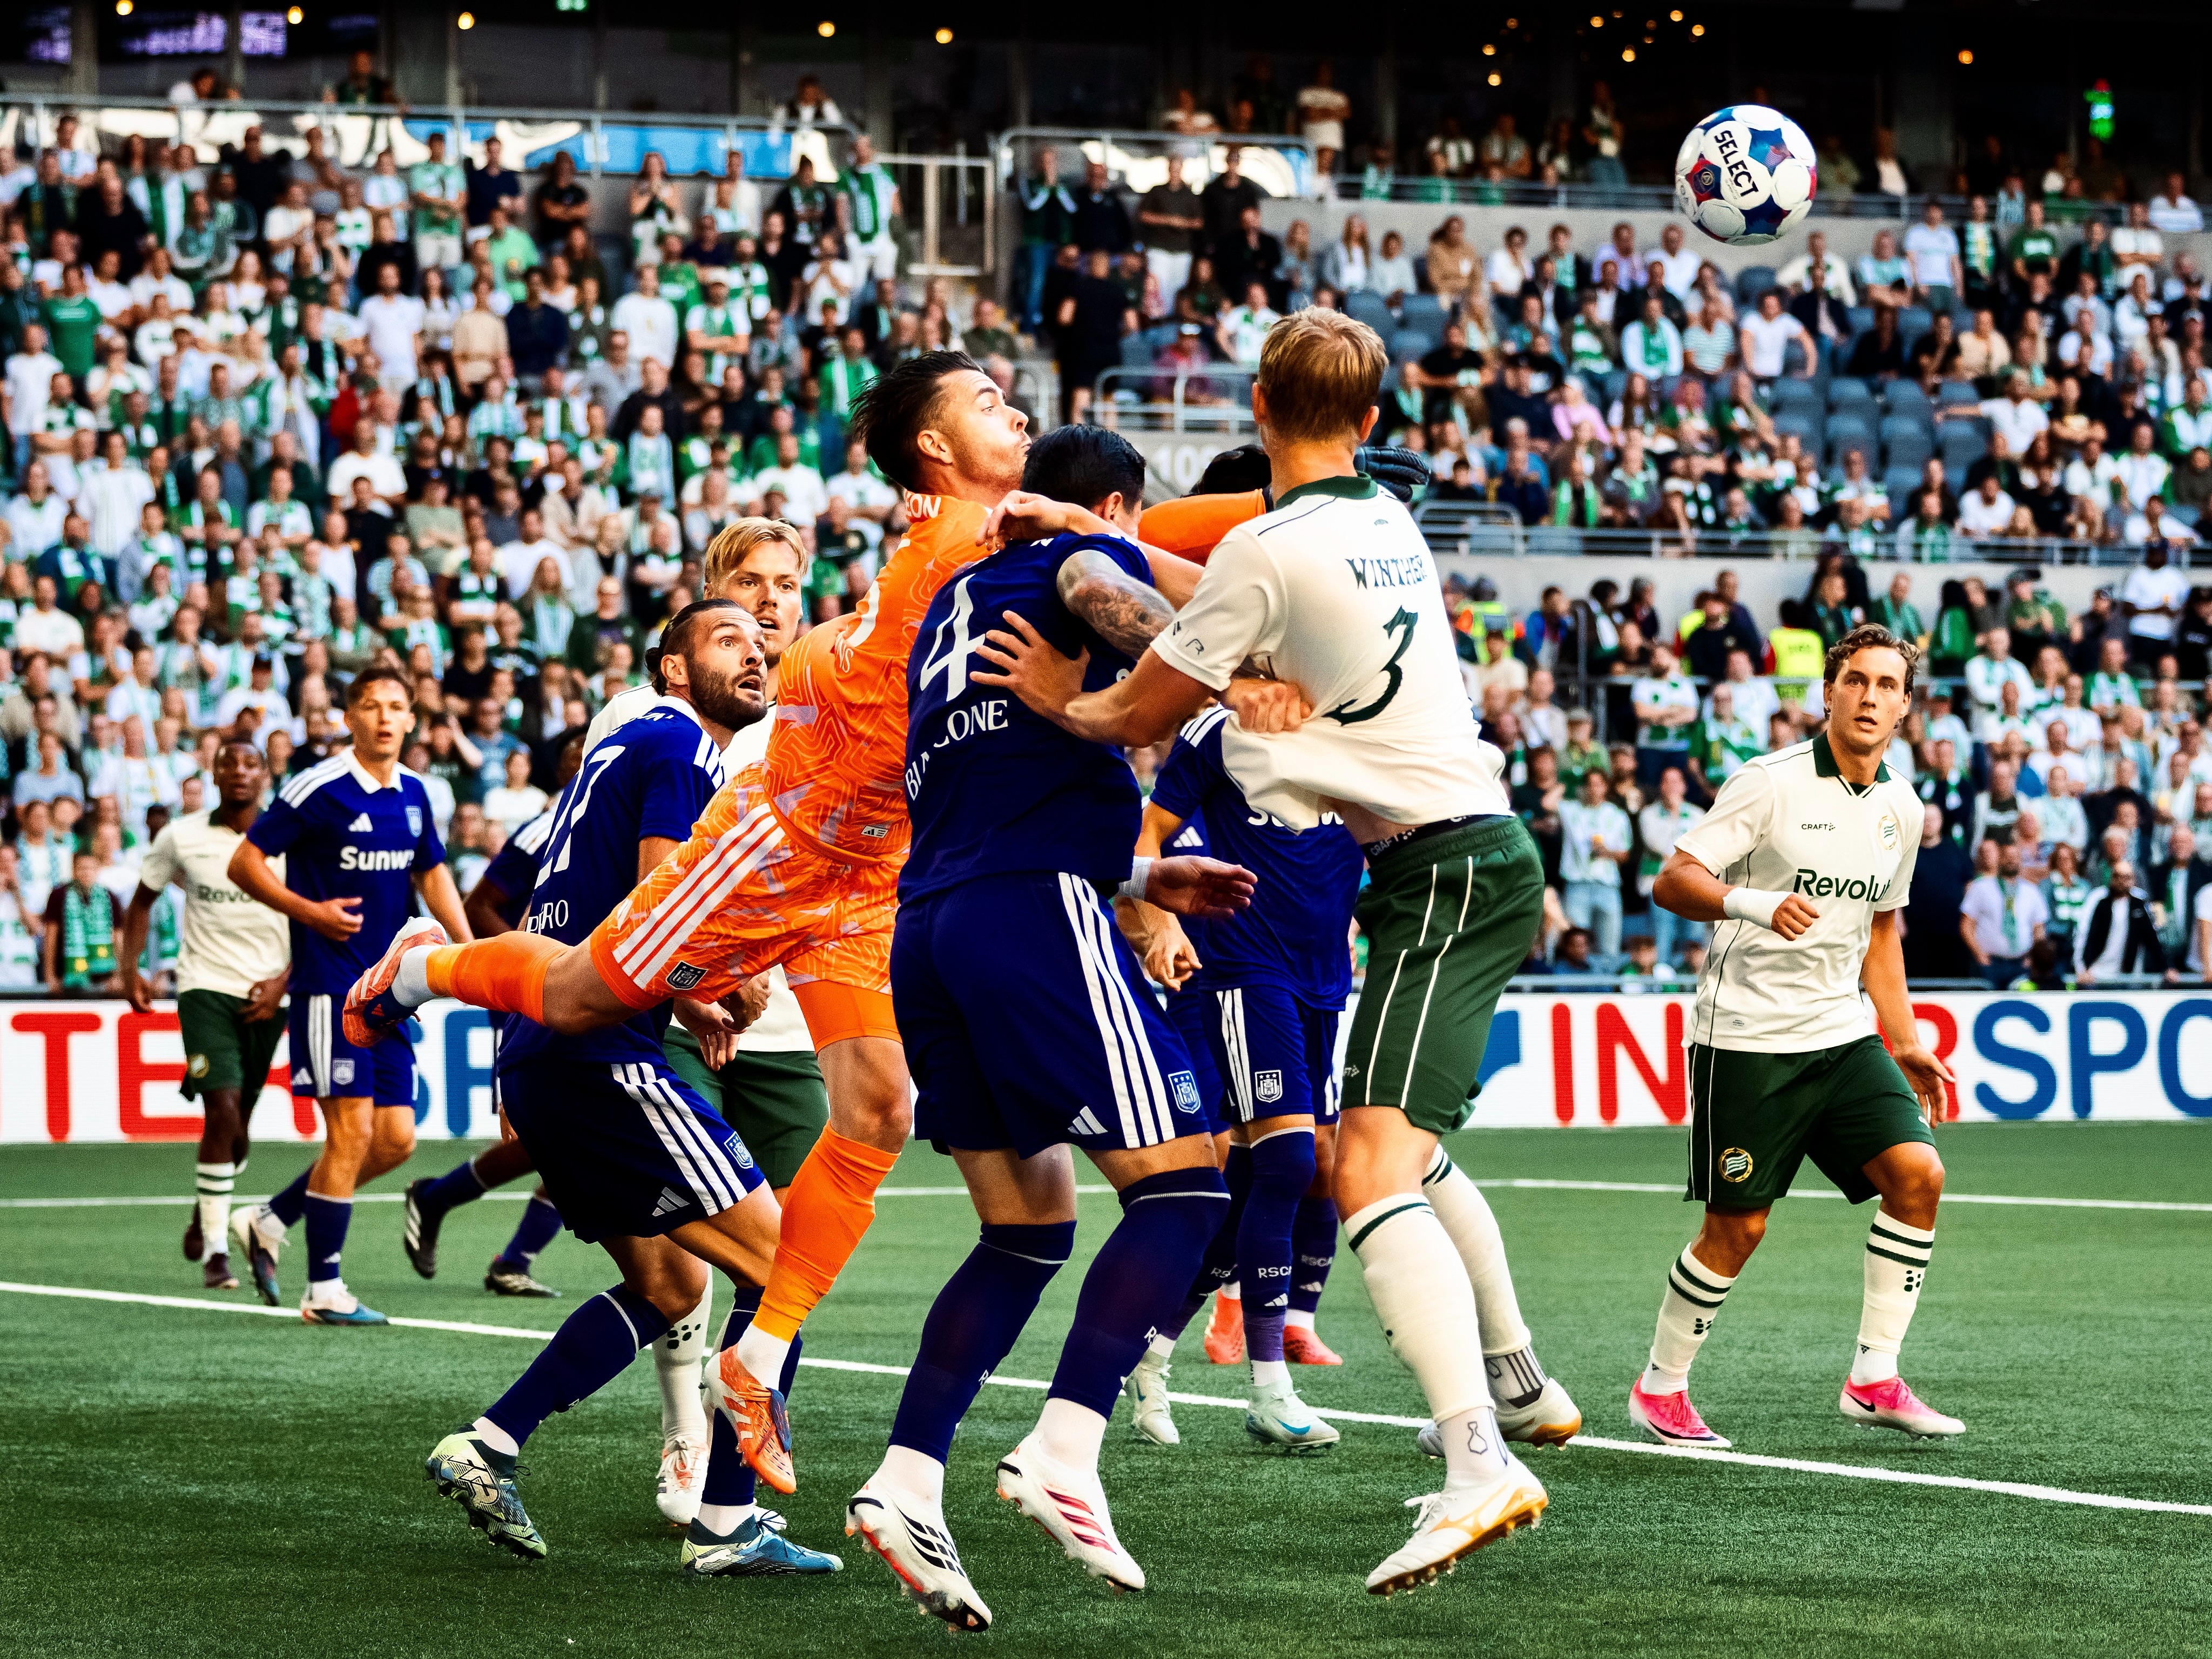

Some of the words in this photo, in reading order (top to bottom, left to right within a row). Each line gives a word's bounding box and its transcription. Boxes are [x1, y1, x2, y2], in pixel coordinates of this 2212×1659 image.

[1714, 130, 1759, 197] SELECT
[920, 574, 986, 702] 4
[1321, 604, 1419, 727] 3
